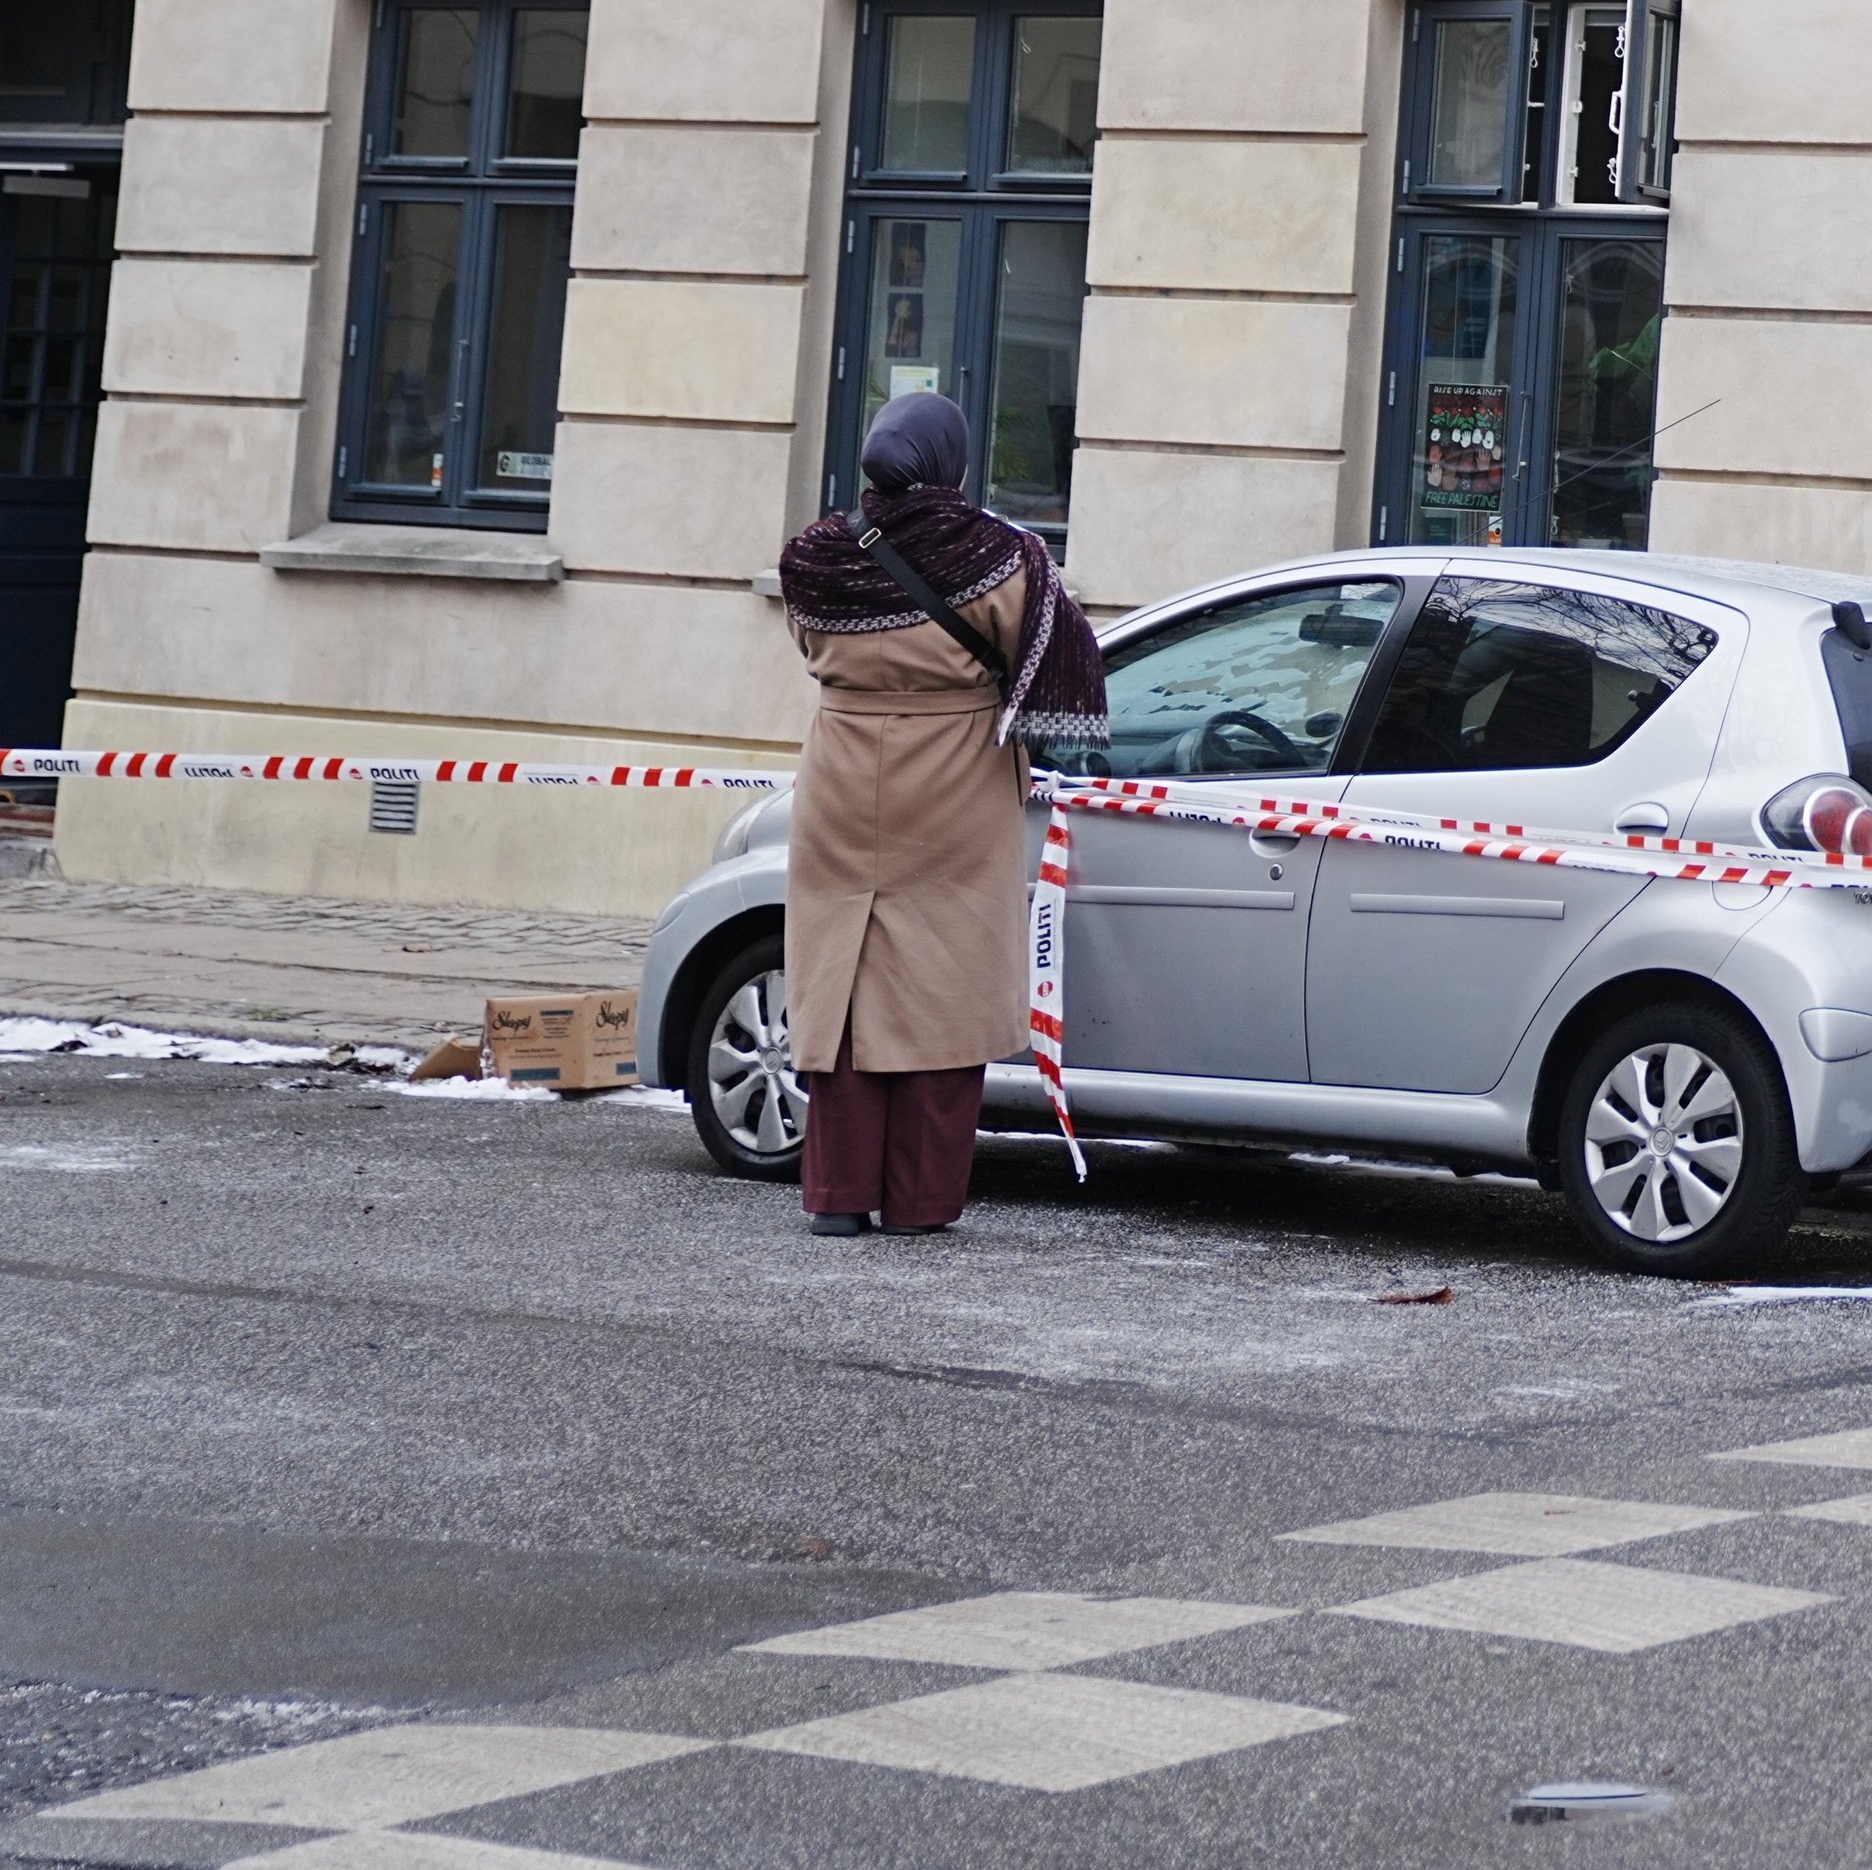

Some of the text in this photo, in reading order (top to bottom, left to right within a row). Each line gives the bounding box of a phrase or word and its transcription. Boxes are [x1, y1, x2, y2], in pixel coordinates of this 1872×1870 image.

[1434, 386, 1452, 394] RISE
[1464, 388, 1502, 396] AGAINST
[1425, 492, 1498, 508] FREE PALESTINE
[34, 759, 80, 772] POLITI
[370, 768, 420, 780] POLITI
[1037, 903, 1051, 968] POLITI
